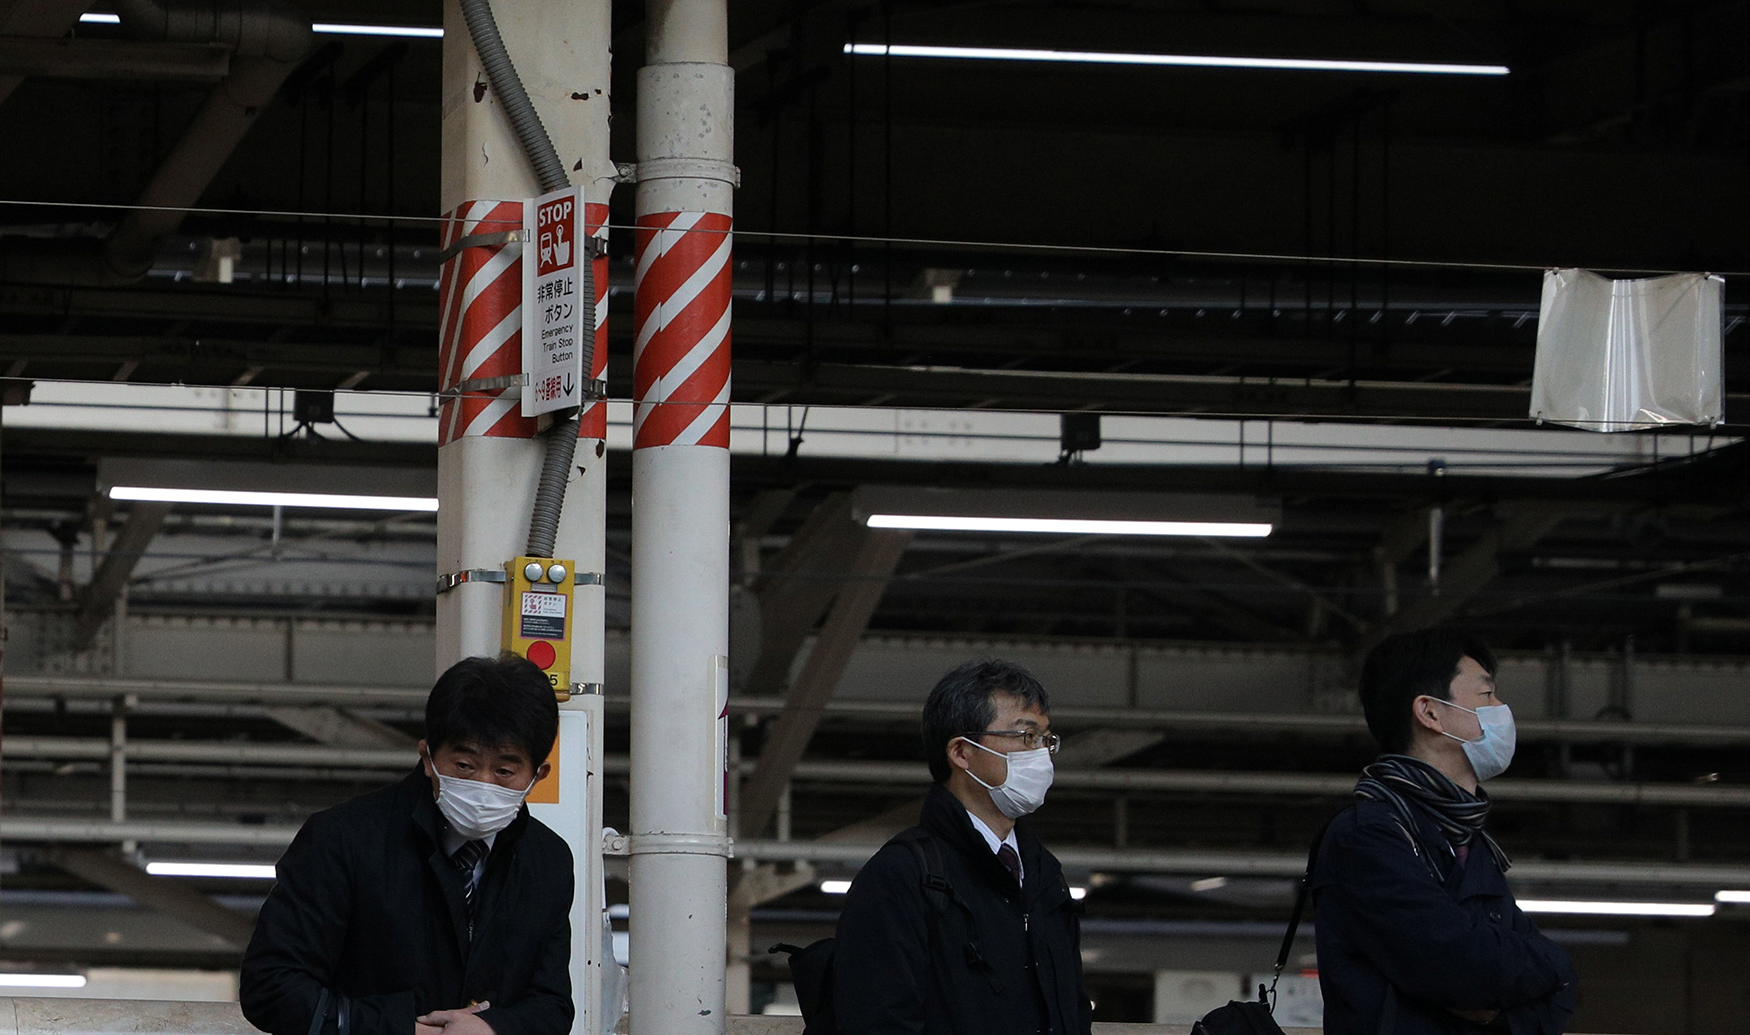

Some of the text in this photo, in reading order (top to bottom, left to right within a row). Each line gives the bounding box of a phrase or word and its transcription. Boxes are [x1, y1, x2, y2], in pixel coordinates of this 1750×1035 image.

[538, 201, 572, 227] STOP
[537, 279, 573, 303] 非常停止
[544, 304, 573, 325] ボタン
[541, 324, 573, 340] Emergency
[542, 338, 573, 352] Train Stop
[552, 350, 573, 364] Button
